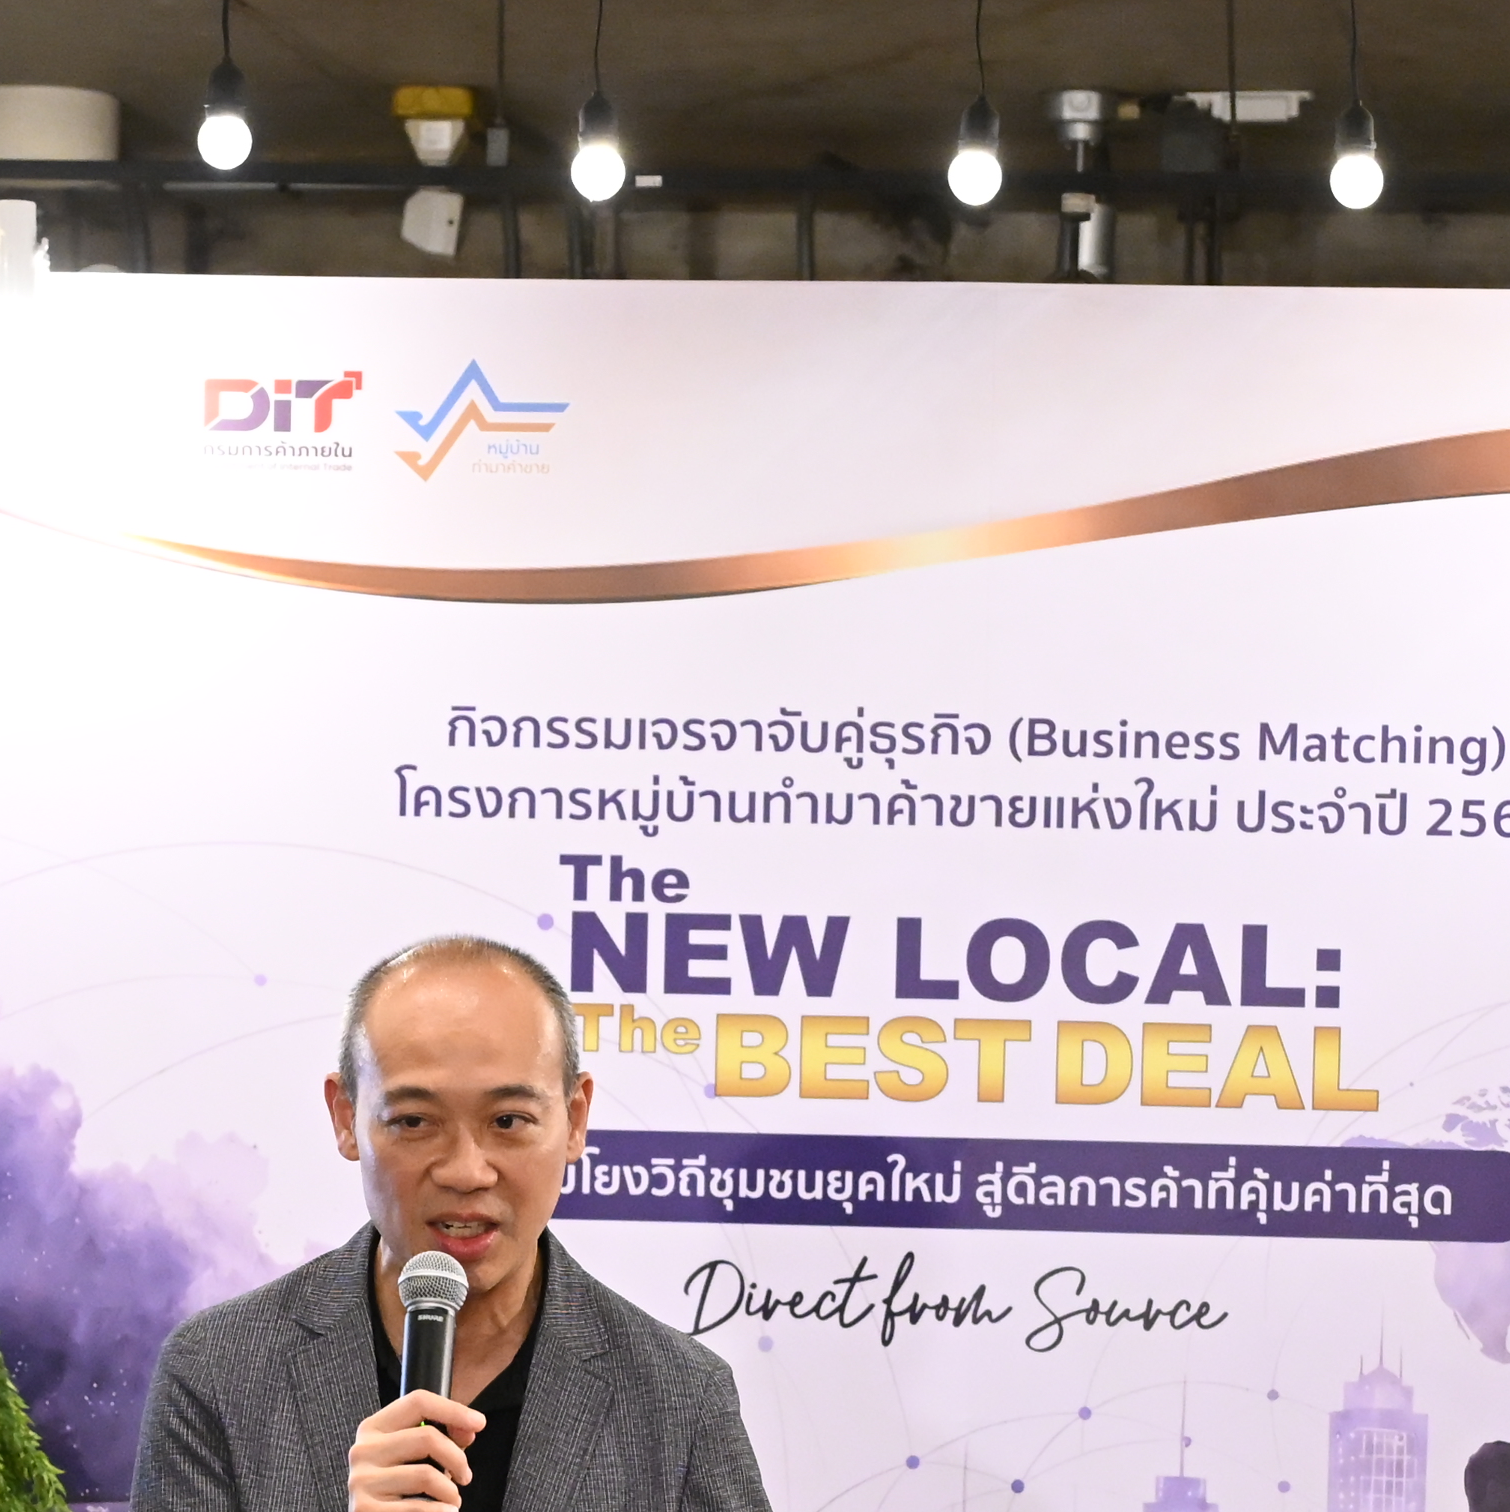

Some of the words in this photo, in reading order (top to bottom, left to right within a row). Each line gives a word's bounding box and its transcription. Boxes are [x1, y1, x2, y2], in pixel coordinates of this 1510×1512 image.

[204, 440, 353, 458] กรมการค้าภายใน
[487, 439, 540, 459] หมู่บ้าน
[447, 705, 993, 771] กิจกรรมเจรจาจับคู่ธุรกิจ
[1008, 716, 1241, 764] (Business
[1258, 722, 1507, 777] Matching)
[394, 763, 1218, 838] โครงการหมู่บ้านทำมาค้าขายแห่งใหม่
[1236, 786, 1408, 836] ประจำปี
[559, 853, 690, 904] The
[569, 910, 851, 998] NEW
[894, 916, 1342, 1009] LOCAL:
[572, 1003, 701, 1055] The
[714, 1013, 1032, 1104] BEST
[1055, 1021, 1380, 1112] DEAL
[975, 1155, 1452, 1218] สู่ดีลการค้าที่คุ้มค่าที่สุด
[682, 1254, 877, 1337] Direct
[879, 1250, 1013, 1348] from
[1024, 1266, 1229, 1353] Source
